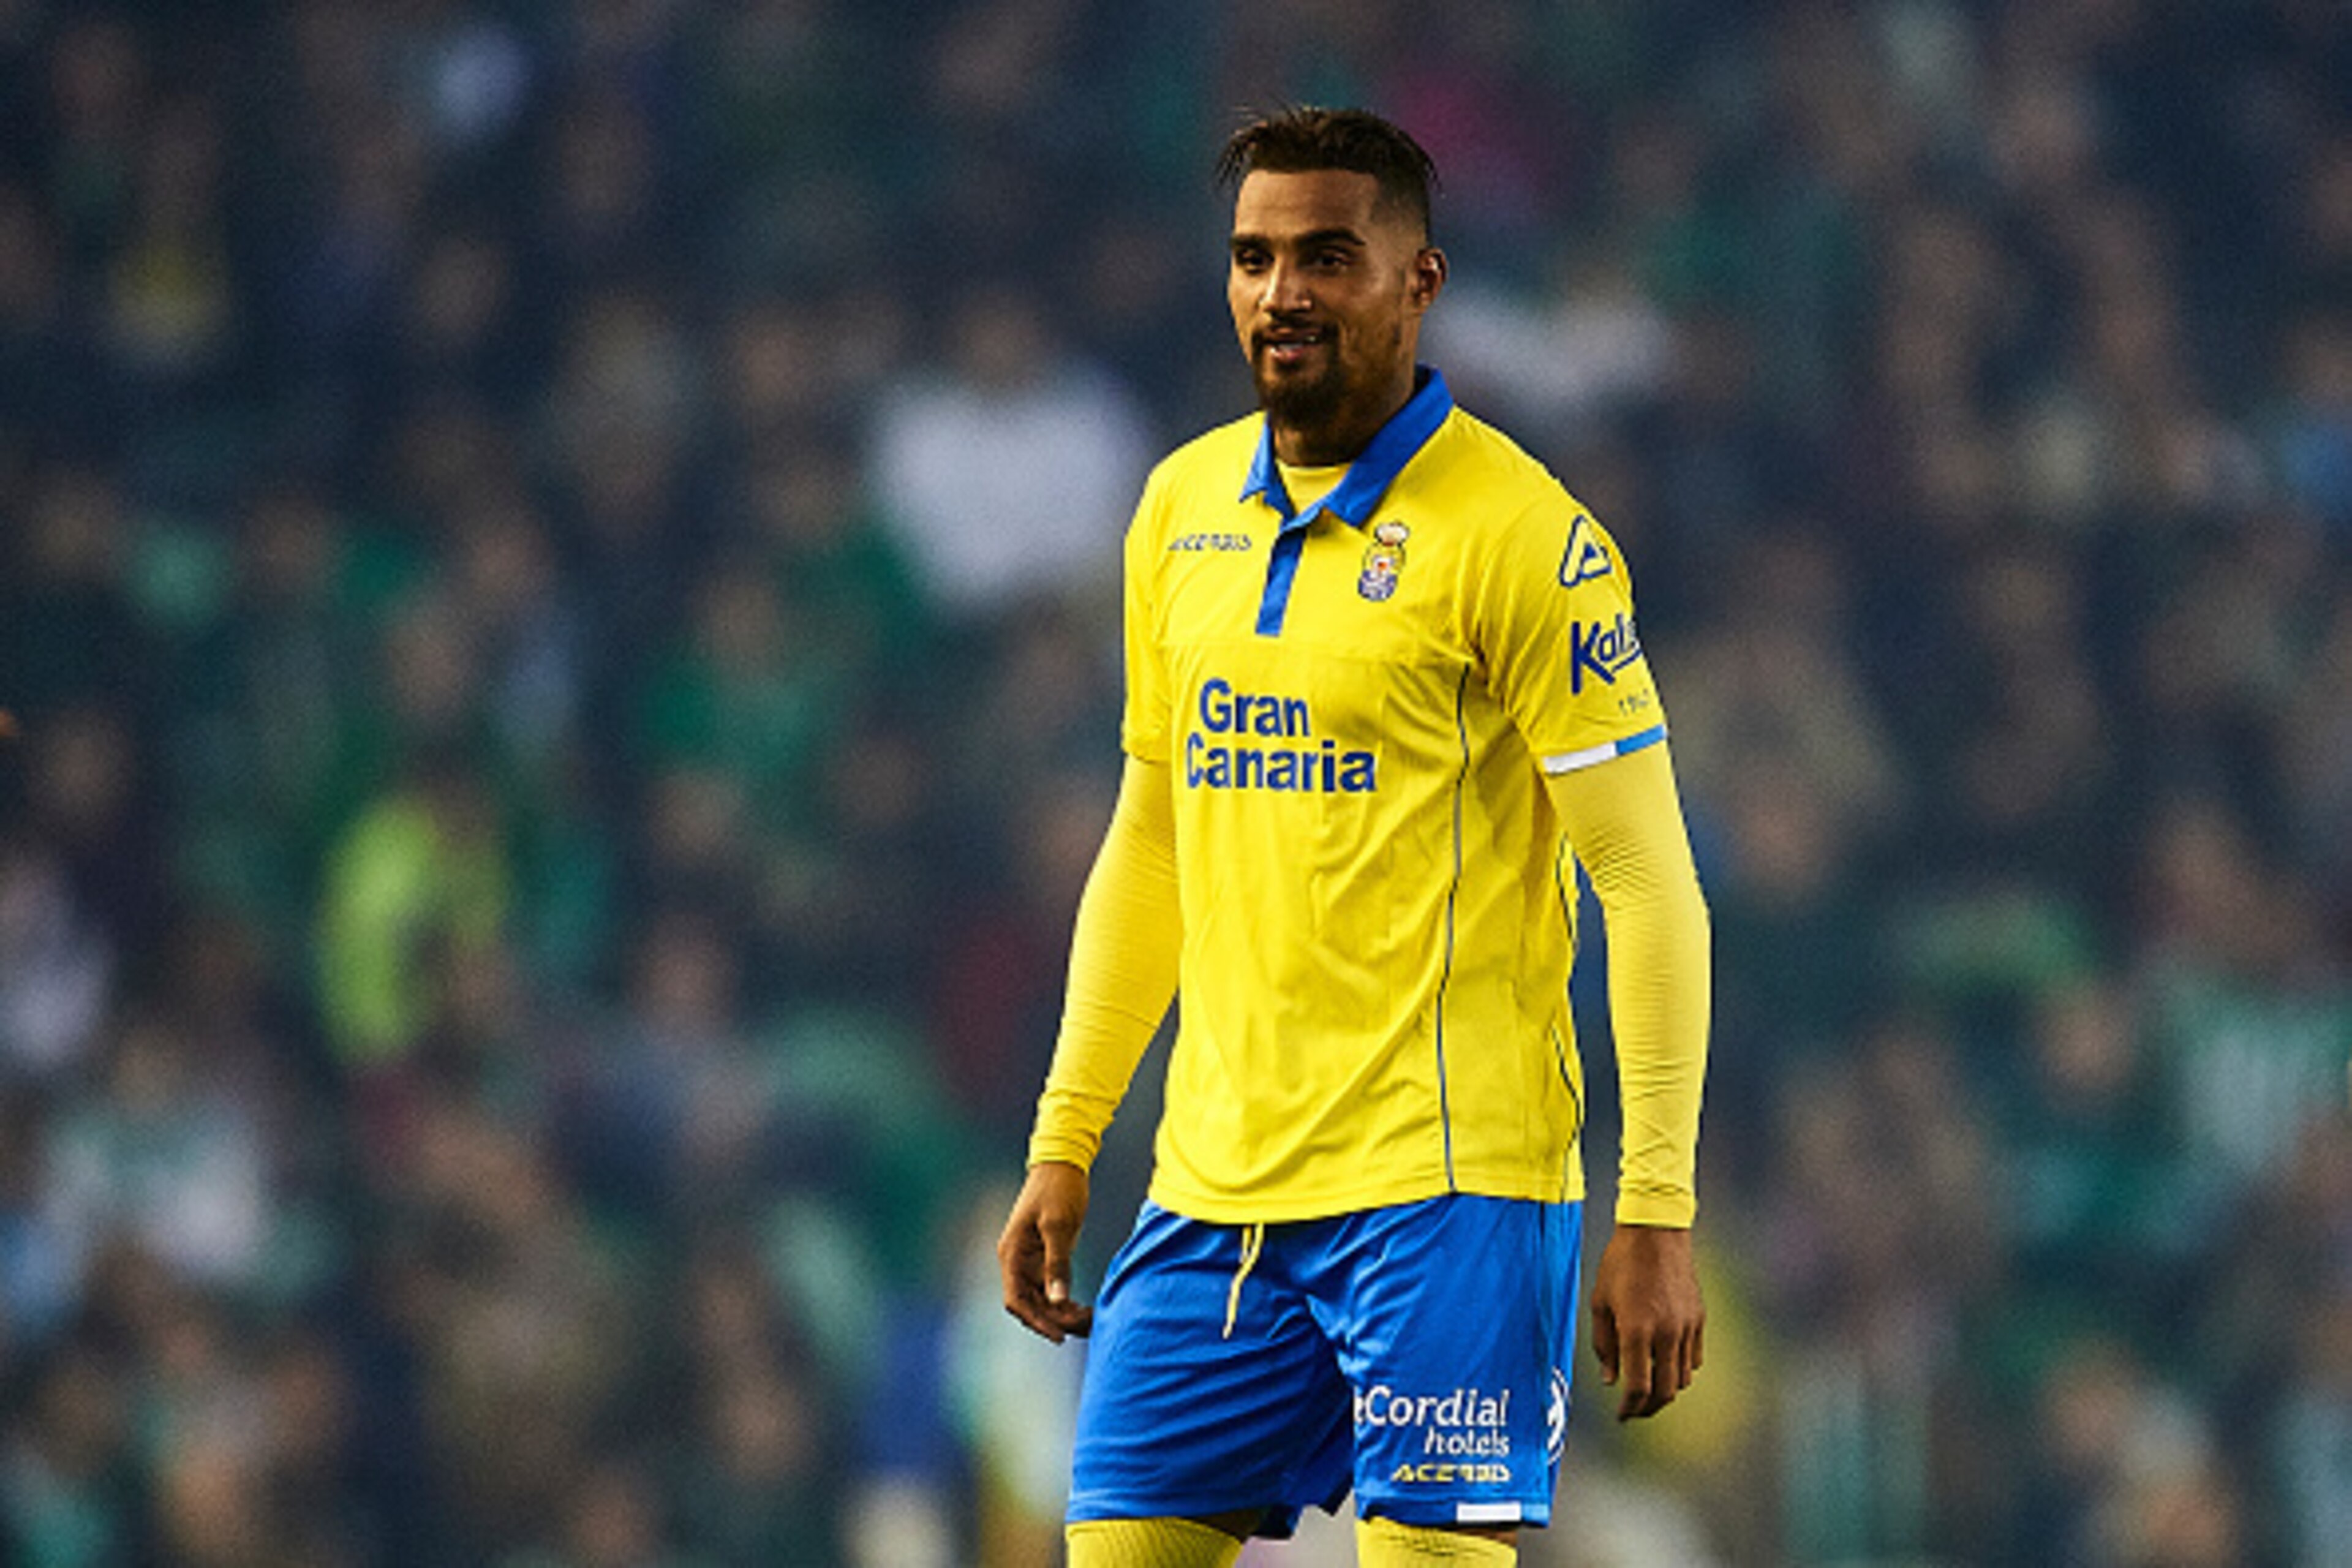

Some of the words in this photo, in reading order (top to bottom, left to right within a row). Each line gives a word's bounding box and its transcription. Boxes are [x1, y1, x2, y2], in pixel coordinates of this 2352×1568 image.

[1199, 677, 1311, 737] Gran
[1186, 732, 1377, 793] Canaria
[1423, 1426, 1511, 1458] hotels
